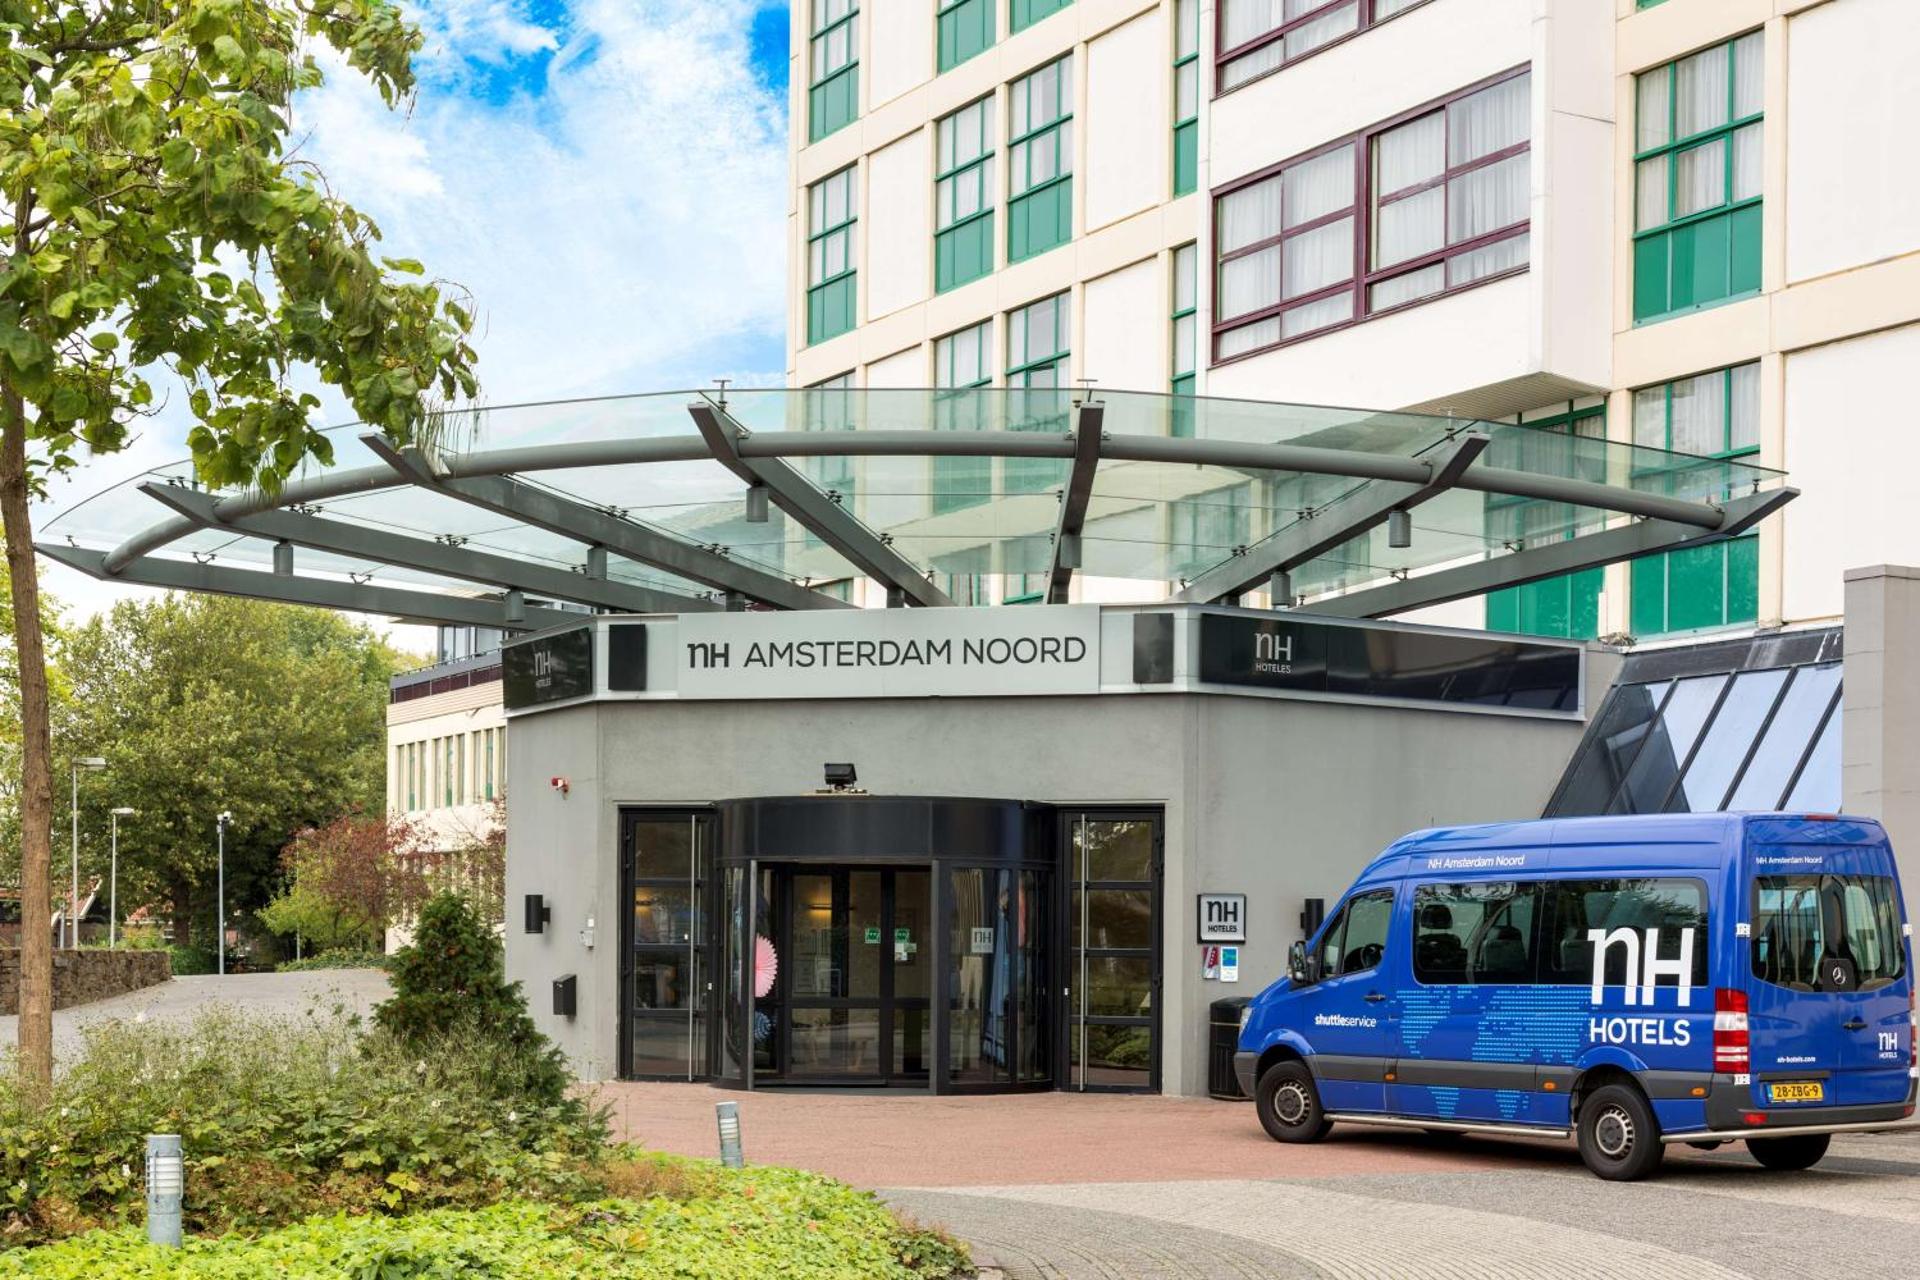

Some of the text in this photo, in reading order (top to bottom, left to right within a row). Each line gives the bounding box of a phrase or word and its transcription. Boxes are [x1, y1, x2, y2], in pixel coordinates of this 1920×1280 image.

[743, 639, 951, 668] AMSTERDAM
[963, 637, 1086, 664] NOORD
[1256, 663, 1291, 674] HOTELES
[1428, 854, 1525, 869] NH Amsterdam Noord
[1208, 924, 1237, 933] HOTELES
[1314, 1013, 1377, 1028] shuttleservice
[1590, 1017, 1691, 1046] HOTELS
[1775, 1085, 1819, 1098] 28-ZBG-9
